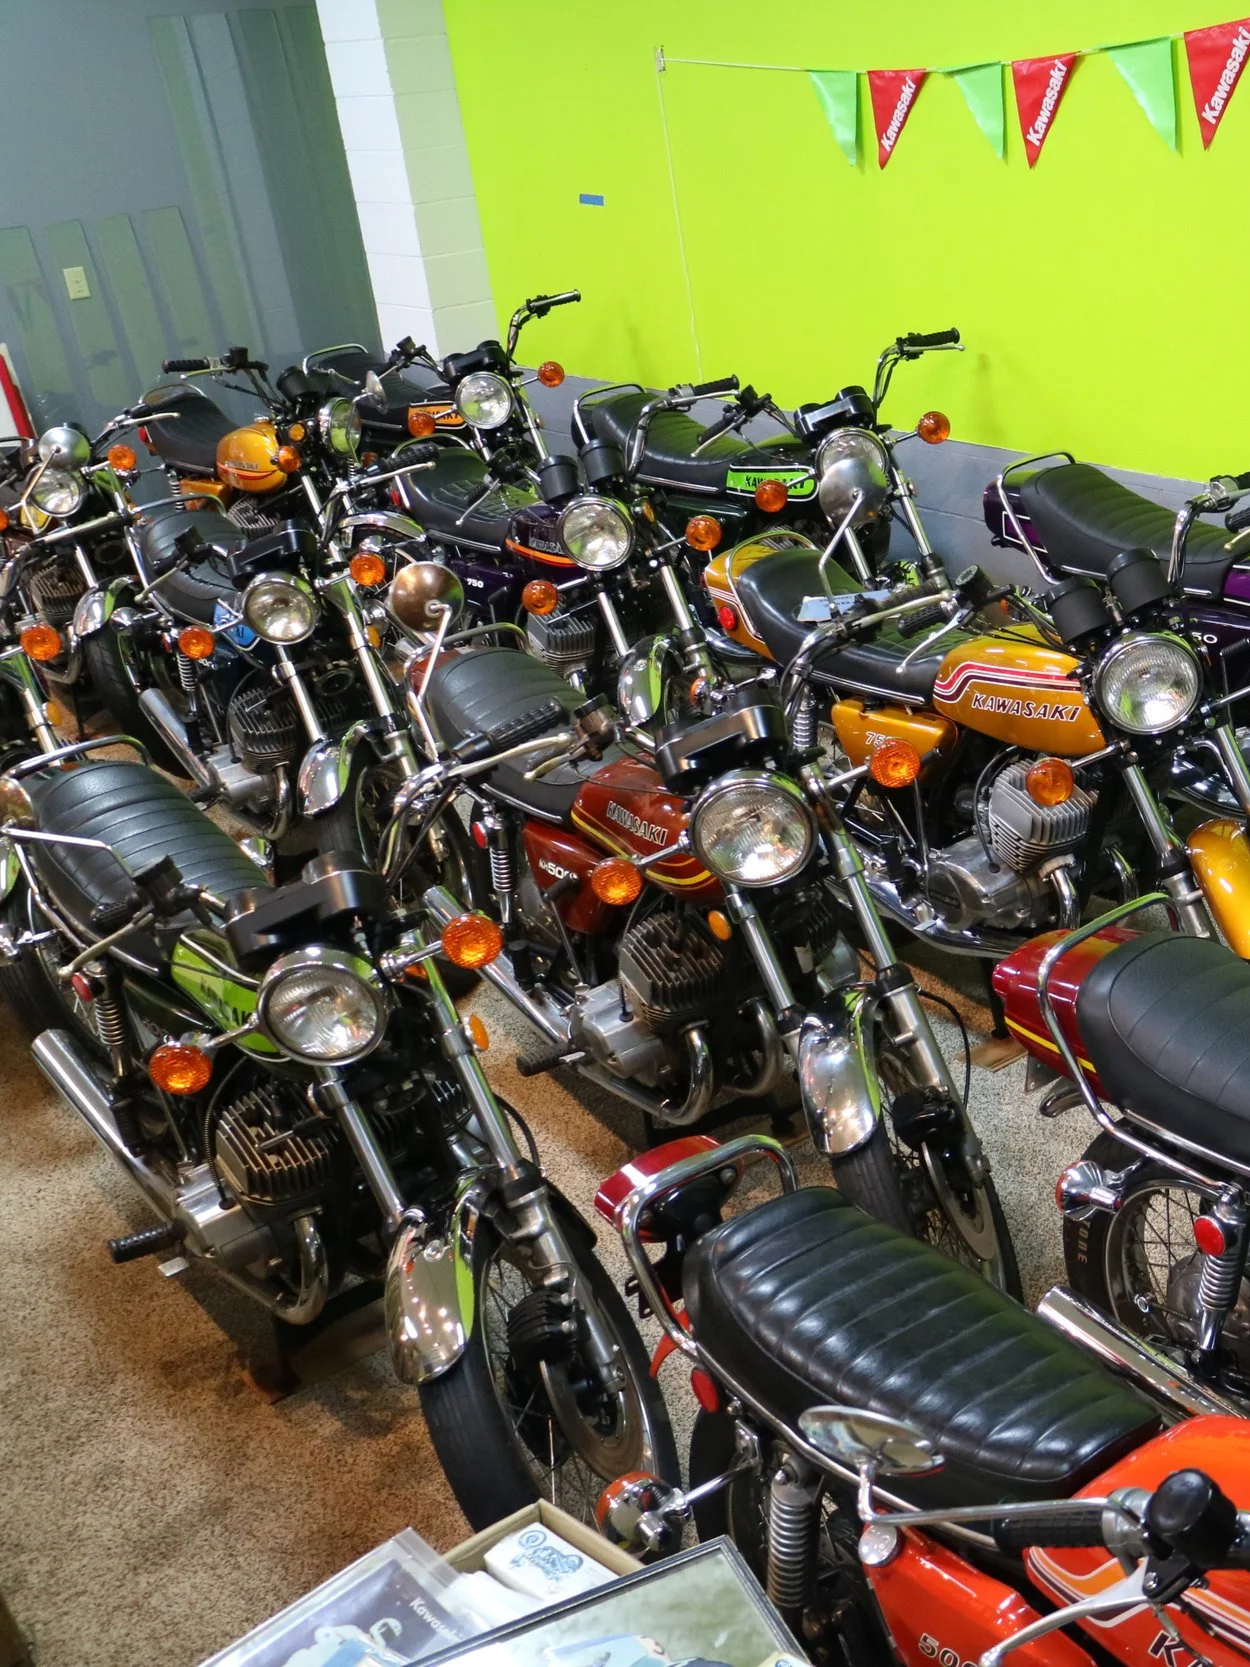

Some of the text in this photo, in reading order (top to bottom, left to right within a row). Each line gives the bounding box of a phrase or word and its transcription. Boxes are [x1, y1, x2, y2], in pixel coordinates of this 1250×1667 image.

[881, 76, 916, 151] Kawasaki
[1027, 59, 1067, 147] Kawasaki
[465, 577, 484, 588] 750
[971, 693, 1082, 722] KAWASAKI
[865, 731, 893, 747] 75
[606, 801, 669, 847] KAWASAKI
[919, 1632, 978, 1667] 50
